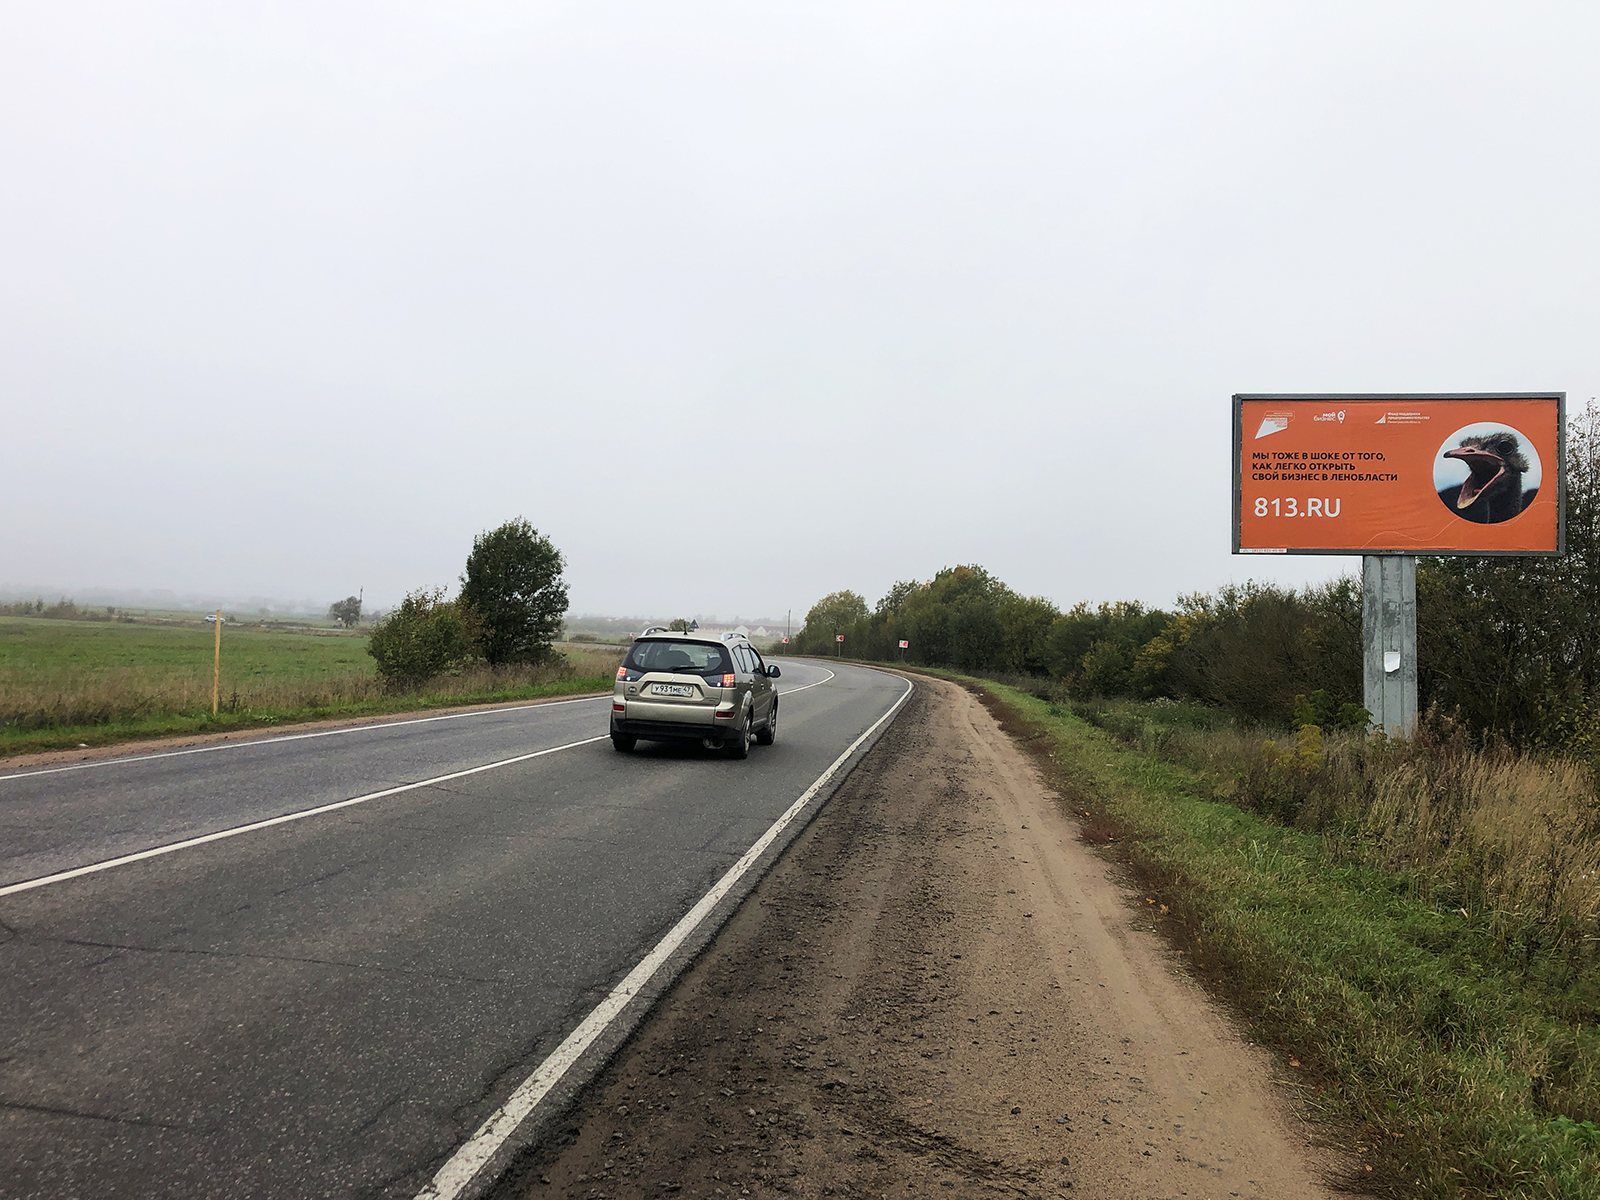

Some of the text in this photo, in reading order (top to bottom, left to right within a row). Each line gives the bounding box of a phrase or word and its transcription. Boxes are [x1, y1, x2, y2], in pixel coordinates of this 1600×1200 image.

[1252, 452, 1386, 461] МЫ ТОЖЕ В ШОКЕ ОТ ТОГО,
[1252, 472, 1398, 481] СВОЙ БИЗНЕС В ЛЕНОБЛАСТИ
[1254, 497, 1341, 518] 813.RU
